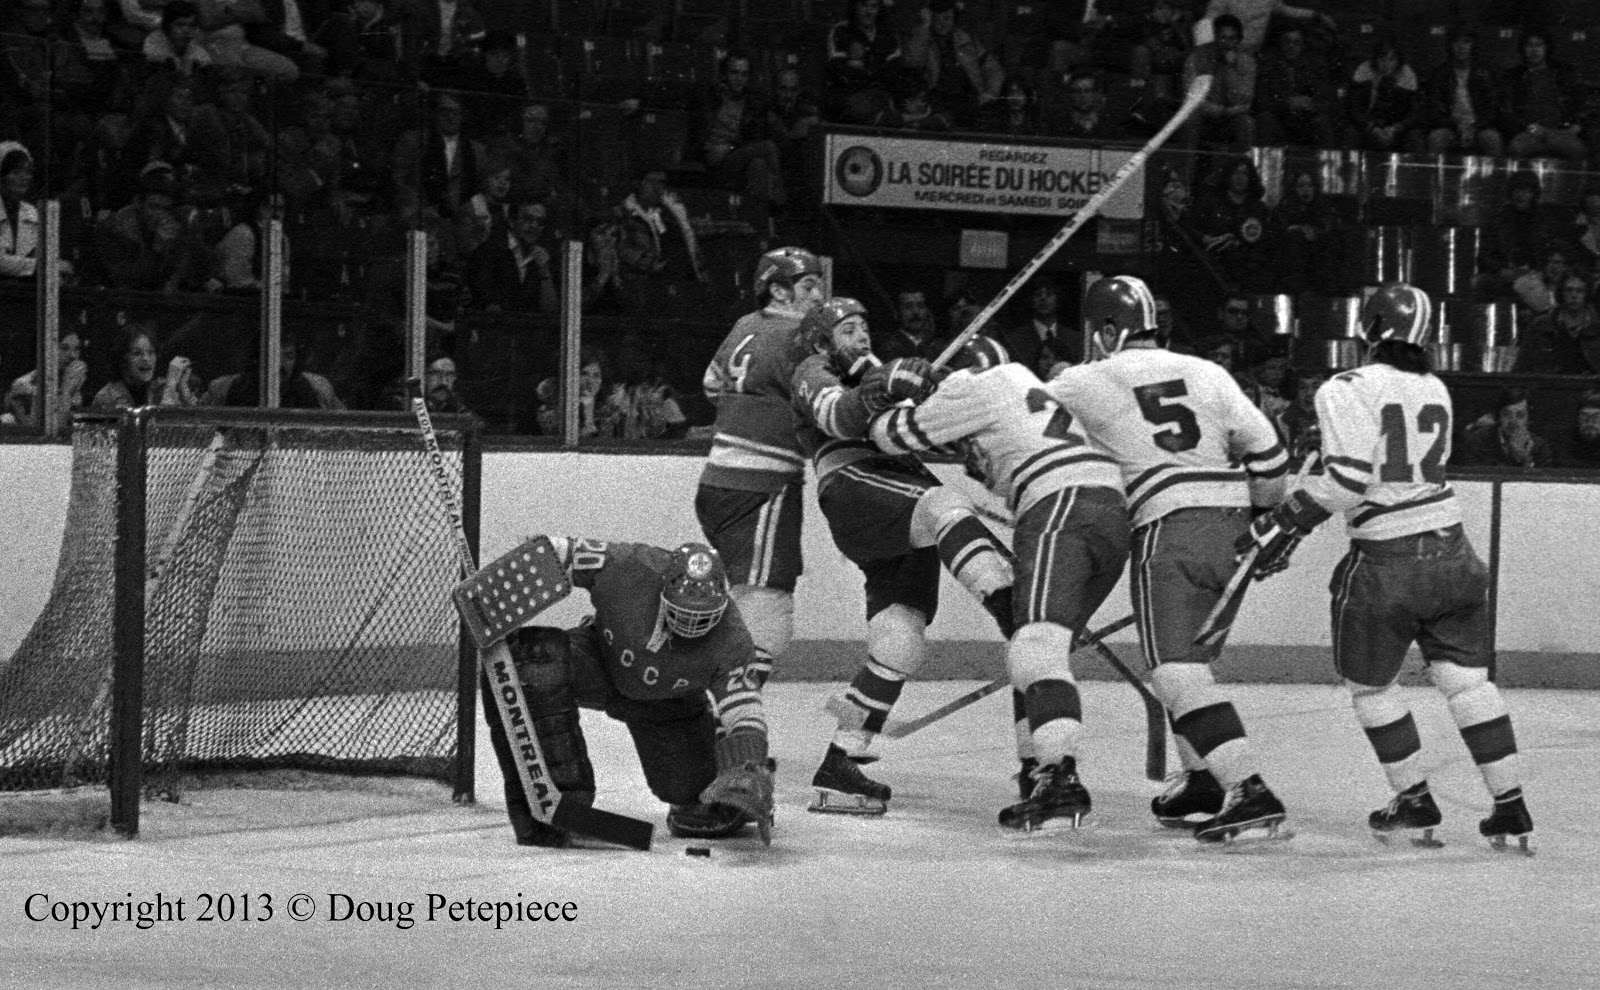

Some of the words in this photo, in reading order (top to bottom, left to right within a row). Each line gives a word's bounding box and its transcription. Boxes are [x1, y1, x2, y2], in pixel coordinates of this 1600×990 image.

[888, 161, 912, 185] LA
[918, 161, 991, 189] SOIRÉE
[995, 166, 1023, 190] DU
[980, 149, 1048, 164] REGARDEZ
[914, 190, 984, 204] MERCREDI
[998, 195, 1052, 208] SAMEDI
[1133, 378, 1201, 453] 5
[1379, 403, 1449, 484] 12
[426, 437, 462, 530] MONTREAL
[493, 660, 553, 815] MONTREAL
